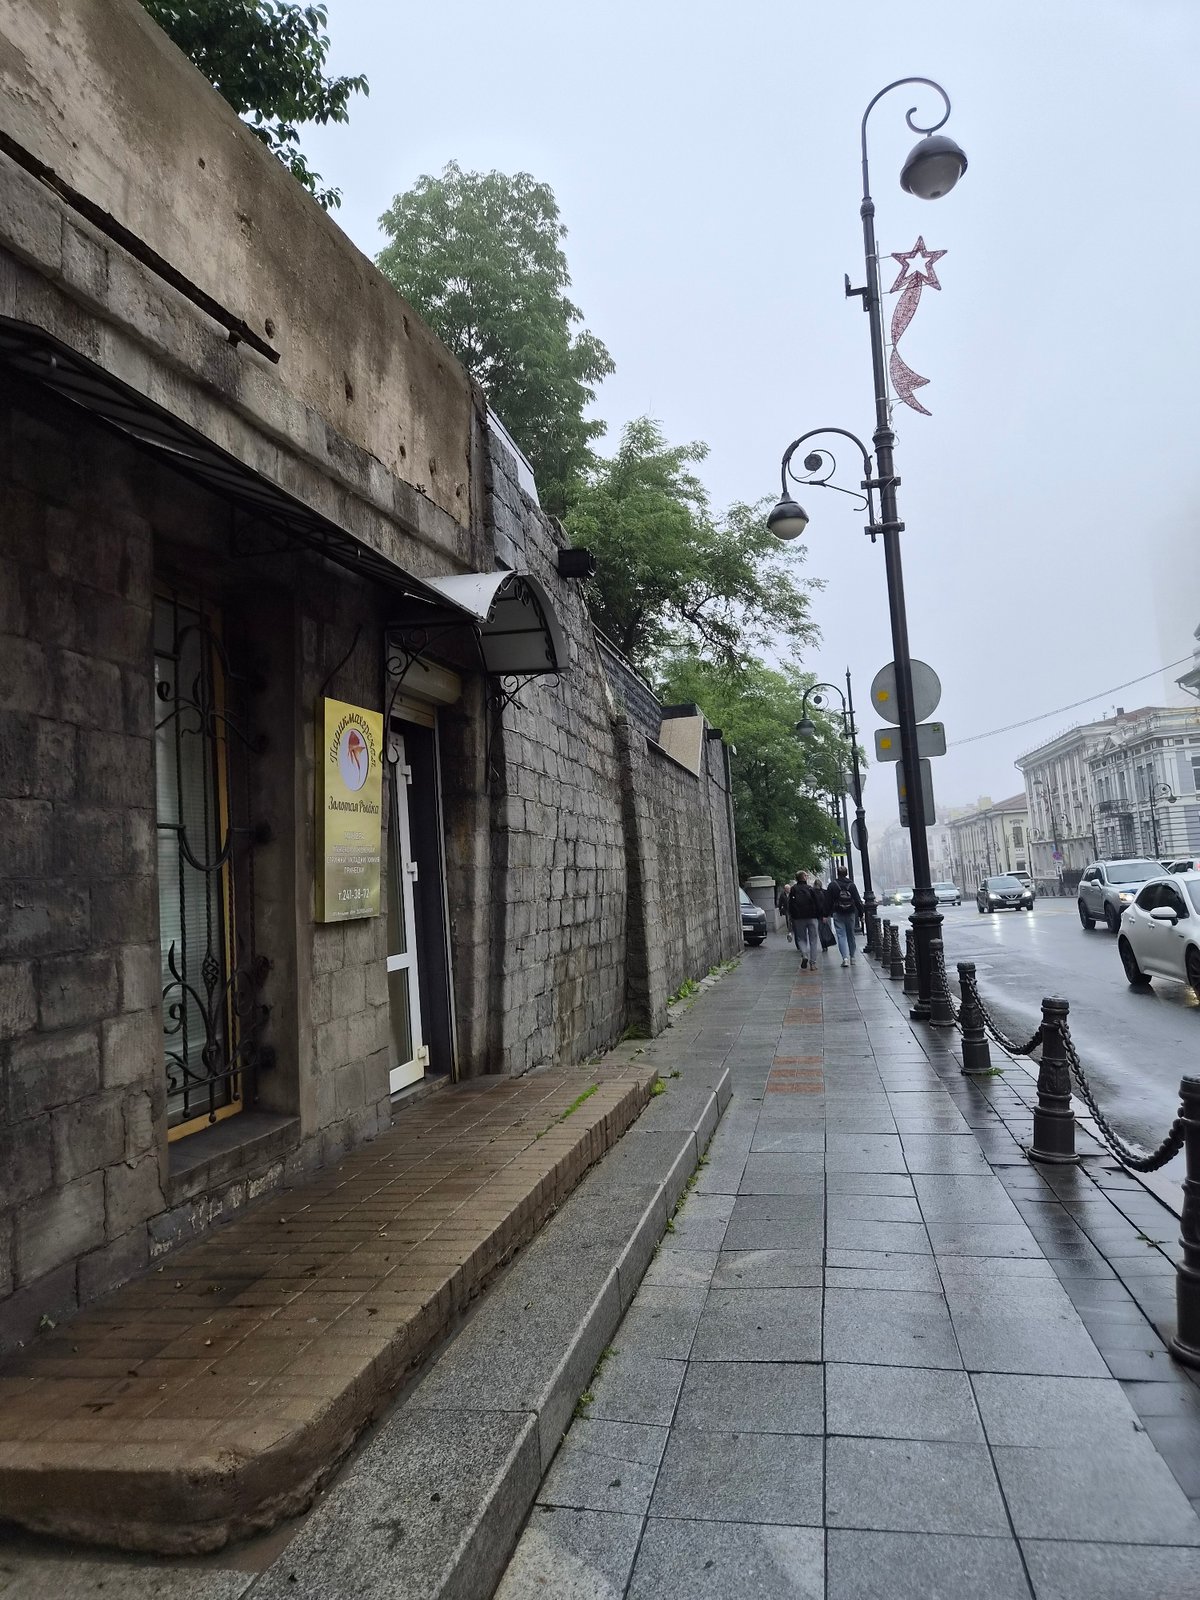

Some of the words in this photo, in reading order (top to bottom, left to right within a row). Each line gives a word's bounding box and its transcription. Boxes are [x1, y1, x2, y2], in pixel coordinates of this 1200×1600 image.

[329, 713, 376, 767] Парикмахерская
[328, 795, 358, 812] Золотая
[359, 800, 379, 814] Рыбка
